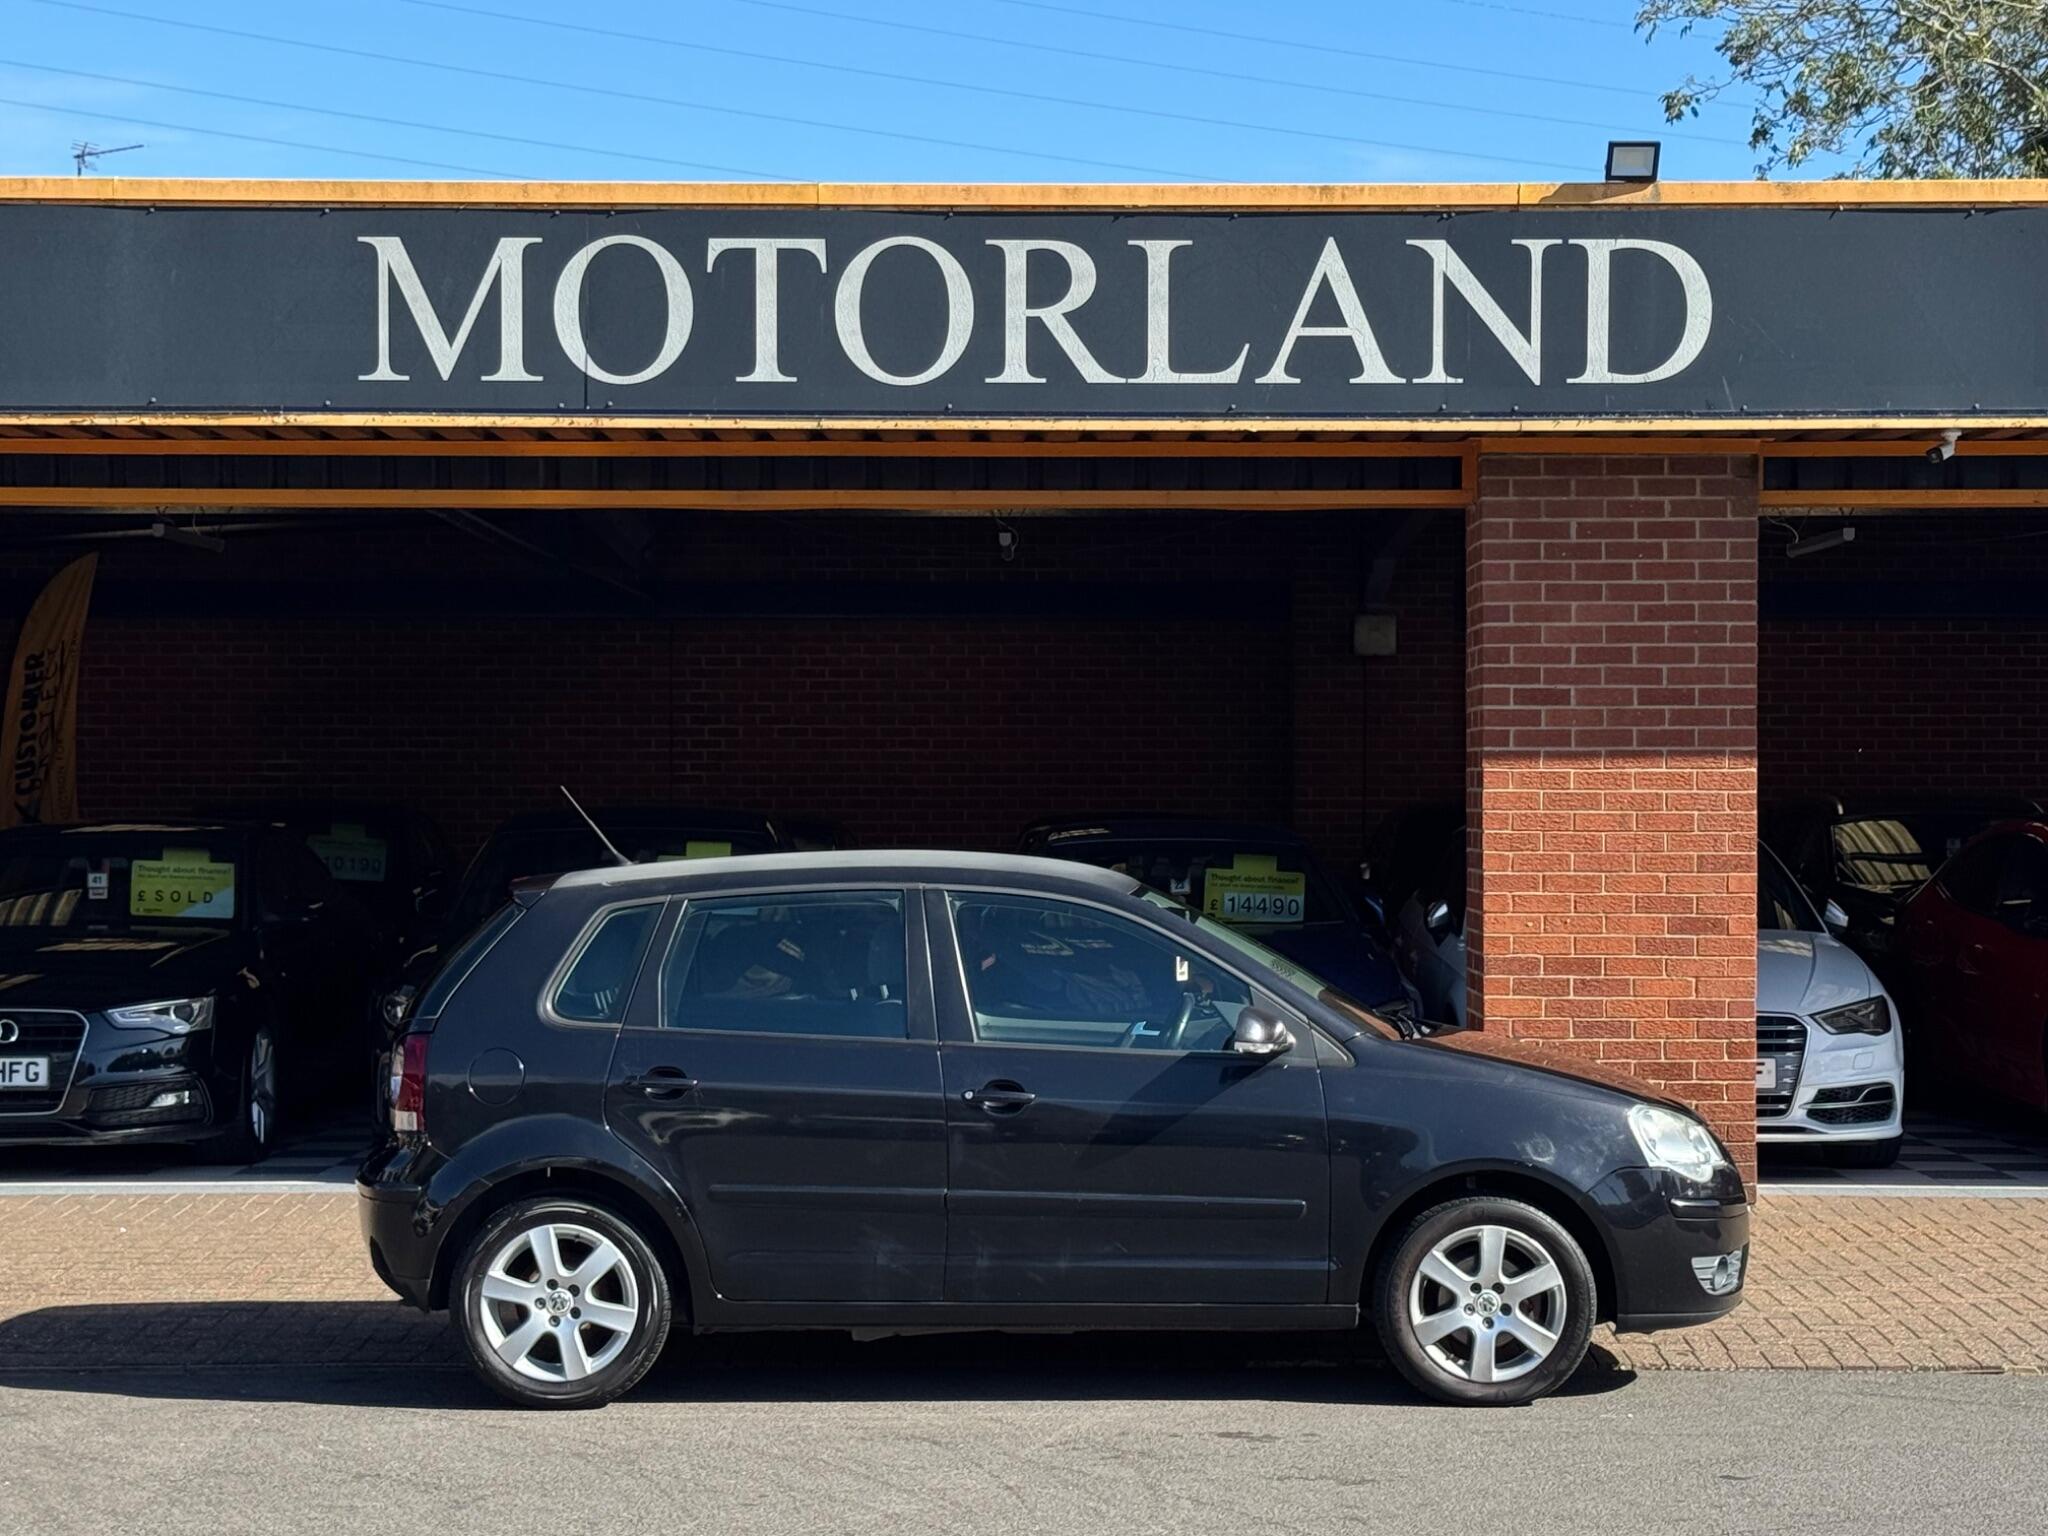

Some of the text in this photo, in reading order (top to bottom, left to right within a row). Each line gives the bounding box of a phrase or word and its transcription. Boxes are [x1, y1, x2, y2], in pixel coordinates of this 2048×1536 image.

[357, 234, 1713, 387] MOTORLAND
[15, 651, 45, 796] CUSTOMER
[155, 889, 214, 904] SOLD
[1227, 896, 1300, 916] 14490
